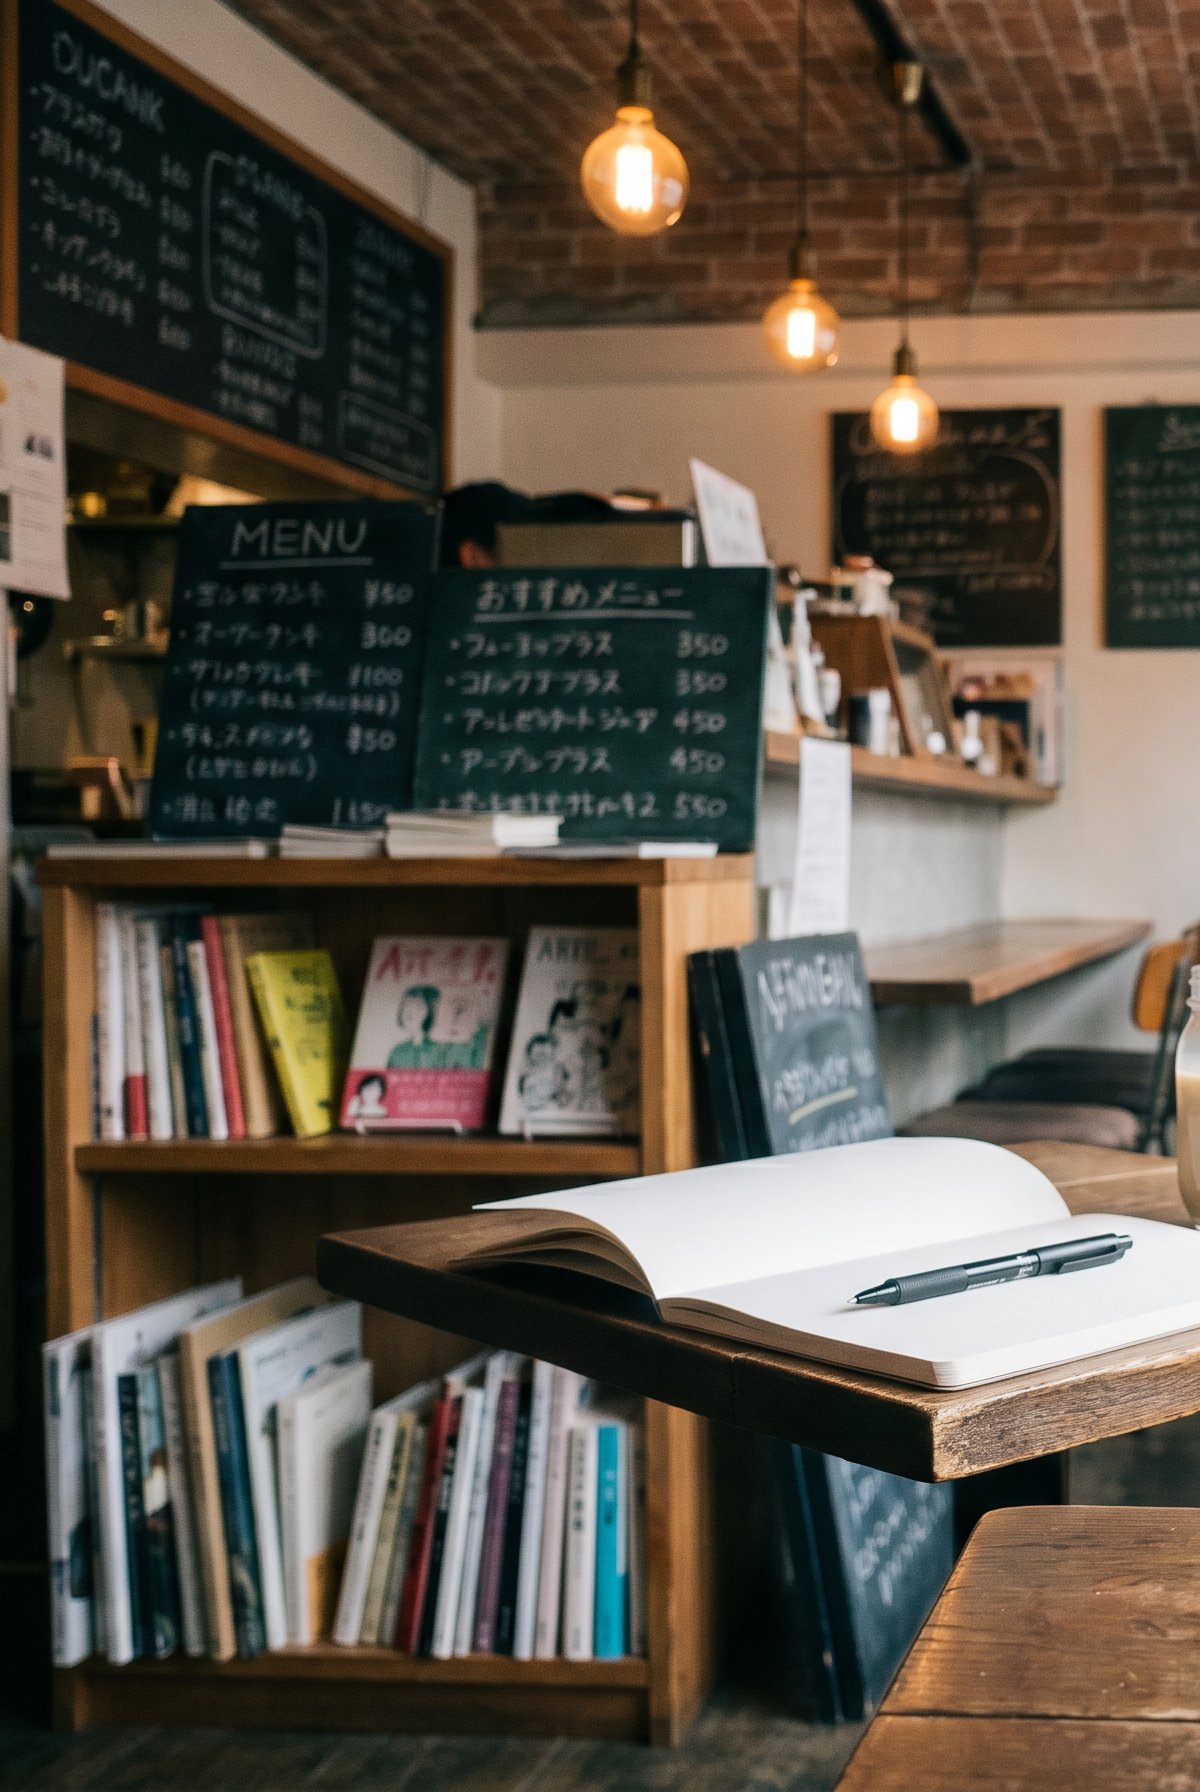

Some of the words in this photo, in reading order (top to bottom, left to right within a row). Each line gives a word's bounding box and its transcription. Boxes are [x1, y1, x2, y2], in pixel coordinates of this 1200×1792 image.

[231, 518, 367, 557] MENU
[677, 632, 729, 658] 350
[671, 709, 728, 734] 450
[669, 747, 726, 773] 450
